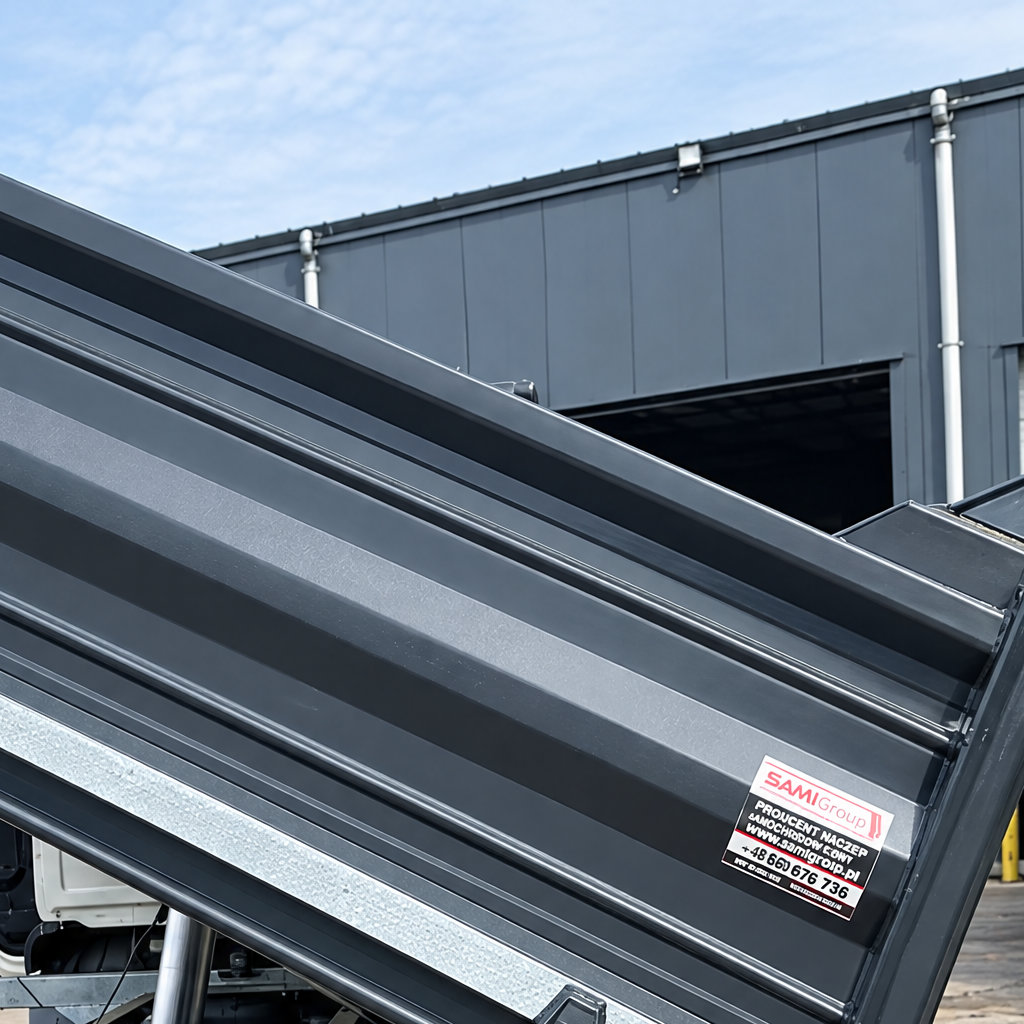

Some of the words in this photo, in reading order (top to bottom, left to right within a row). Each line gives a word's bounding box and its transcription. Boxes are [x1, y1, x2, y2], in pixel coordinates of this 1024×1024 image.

[820, 831, 868, 858] NACZEP
[741, 844, 766, 862] +48
[790, 865, 819, 885] 676
[820, 877, 849, 900] 736
